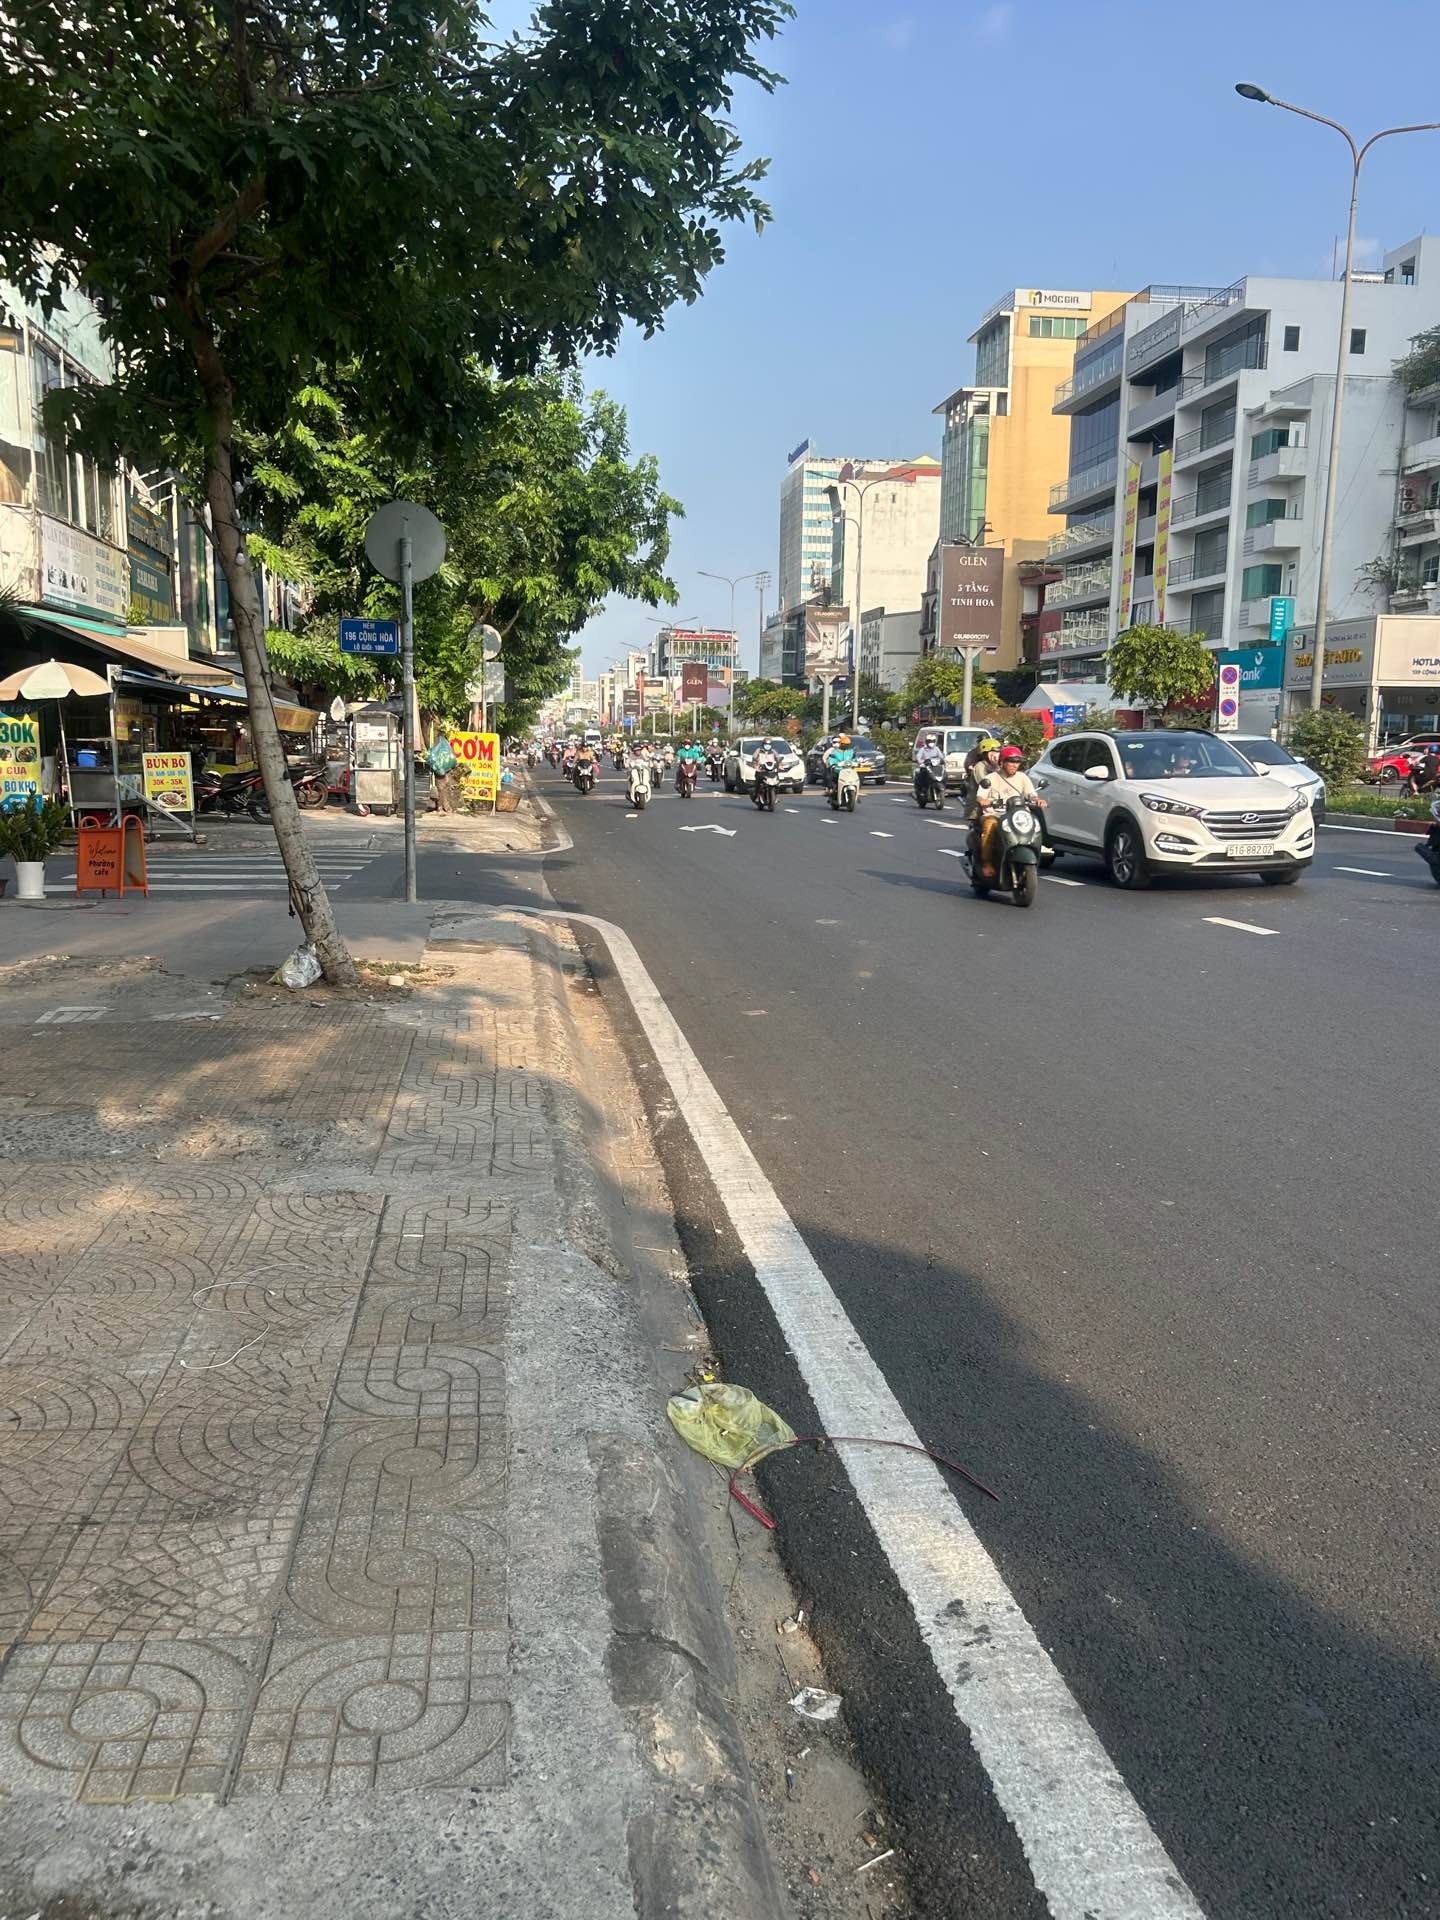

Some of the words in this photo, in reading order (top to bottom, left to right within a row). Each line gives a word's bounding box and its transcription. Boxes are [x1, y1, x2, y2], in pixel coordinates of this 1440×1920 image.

[960, 556, 987, 566] GLEN
[359, 630, 377, 642] CỘNG
[379, 632, 394, 642] HÒA
[450, 735, 494, 761] CƠM
[146, 756, 168, 768] BÚN
[171, 755, 185, 768] BÒ
